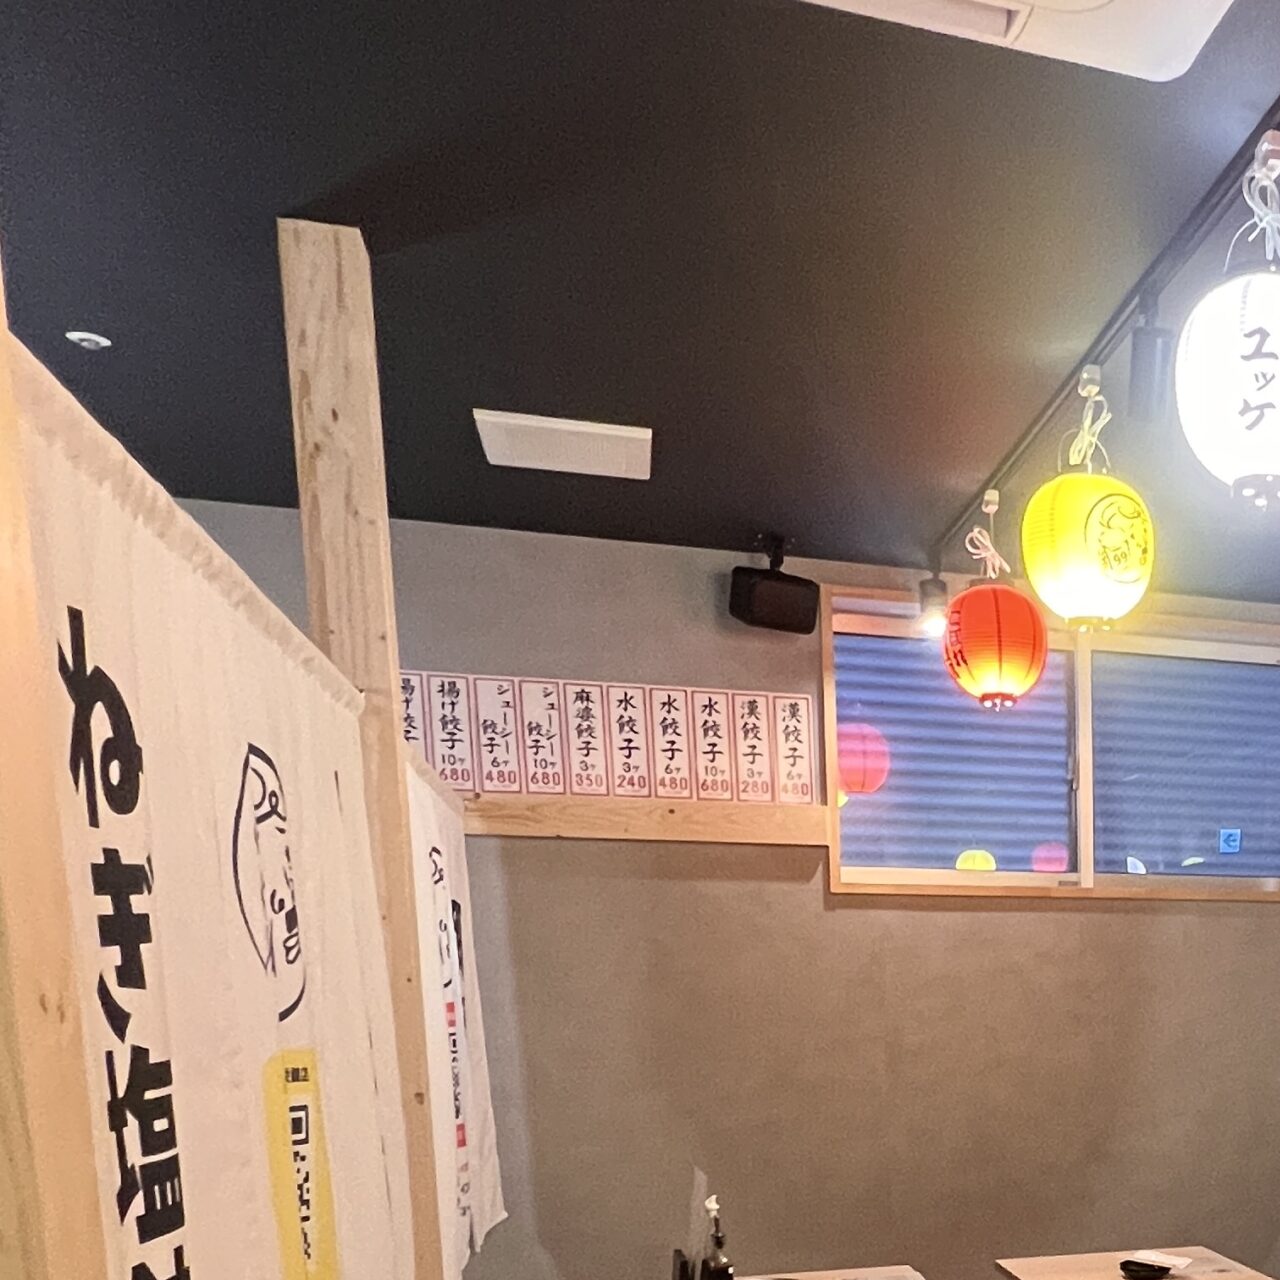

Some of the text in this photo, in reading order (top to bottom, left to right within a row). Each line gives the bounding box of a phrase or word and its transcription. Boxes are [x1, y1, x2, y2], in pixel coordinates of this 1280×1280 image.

[1238, 326, 1279, 430] ユッケ
[437, 680, 463, 750] 揚げ餃子
[616, 691, 640, 759] 水餃子
[660, 693, 683, 761] 水餃子
[701, 697, 724, 763] 水餃子
[740, 699, 763, 764] 漢餃子
[482, 719, 500, 754] 餃子
[527, 721, 545, 756] 餃子
[781, 702, 804, 767] 漢餃子
[439, 768, 470, 781] 680
[485, 771, 517, 784] 480
[531, 772, 560, 785] 680
[575, 773, 603, 787] 350
[617, 775, 646, 788] 240
[659, 777, 687, 790] 480
[701, 779, 728, 792] 680
[741, 781, 769, 793] 280
